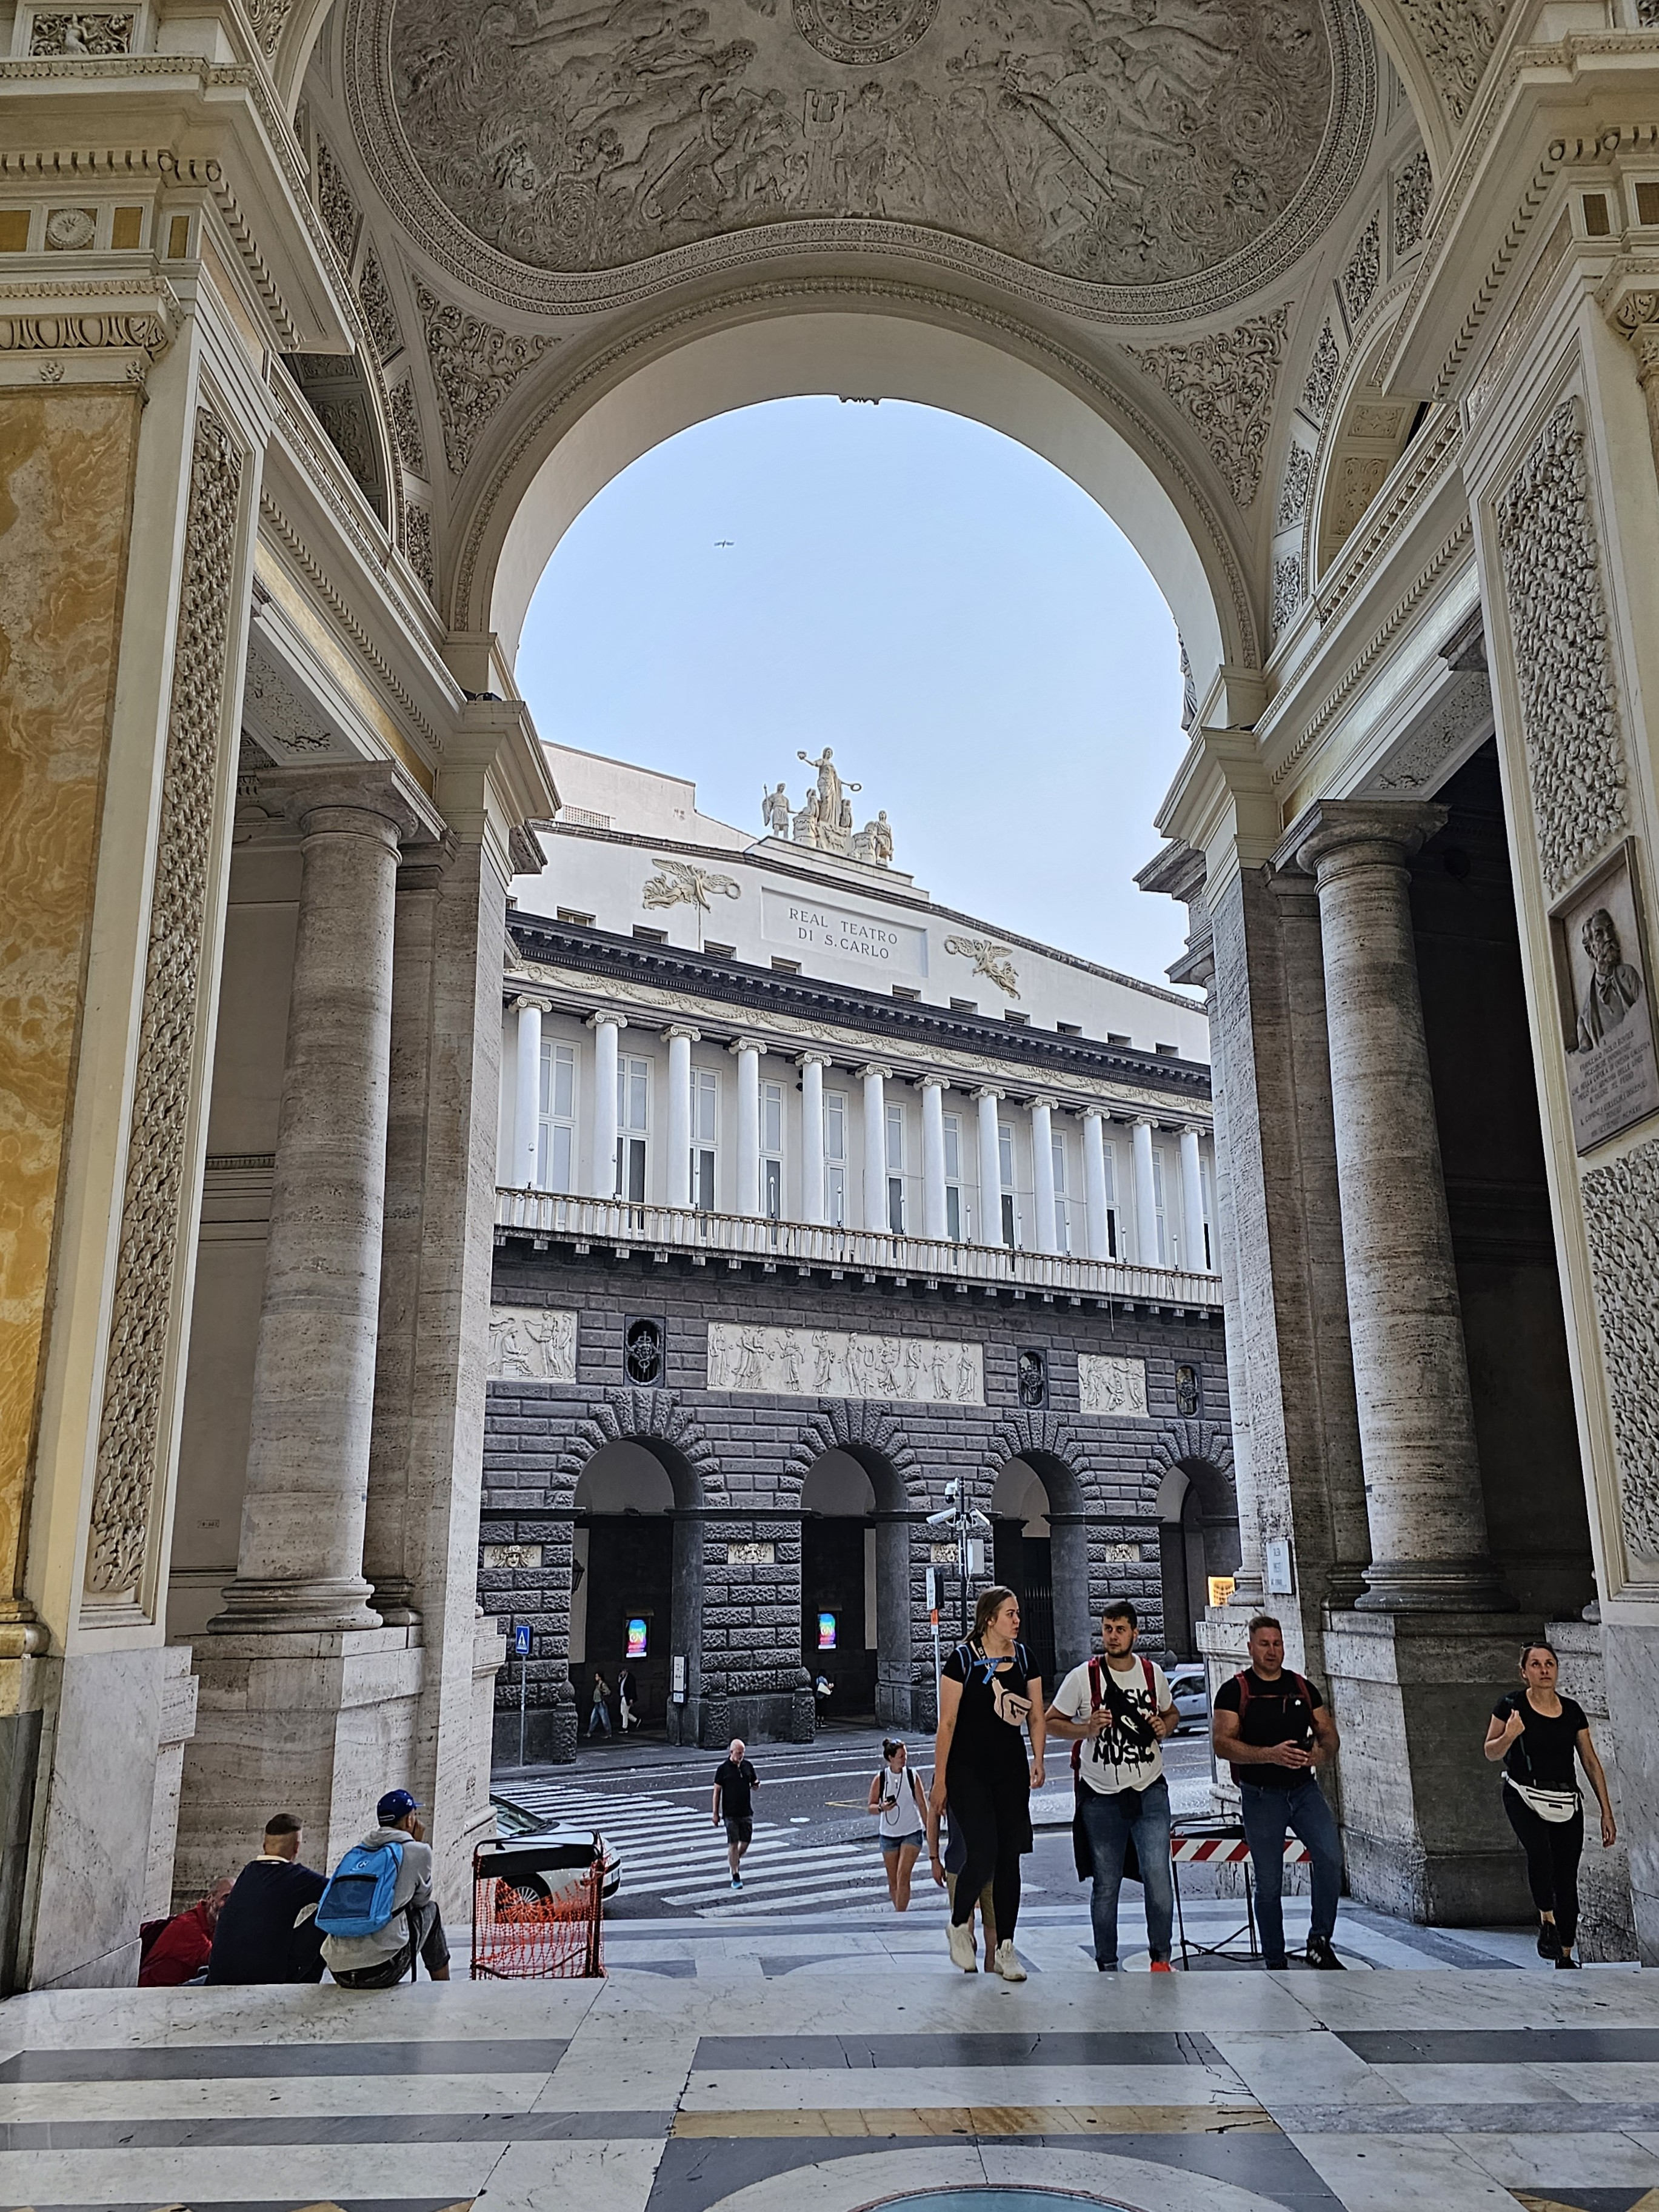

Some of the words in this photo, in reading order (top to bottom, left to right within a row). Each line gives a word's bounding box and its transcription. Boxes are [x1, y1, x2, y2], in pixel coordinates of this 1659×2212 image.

[789, 907, 829, 928] REAL
[841, 920, 898, 944] TEATRO
[798, 927, 813, 941] DI
[1092, 1742, 1155, 1769] MUSIC
